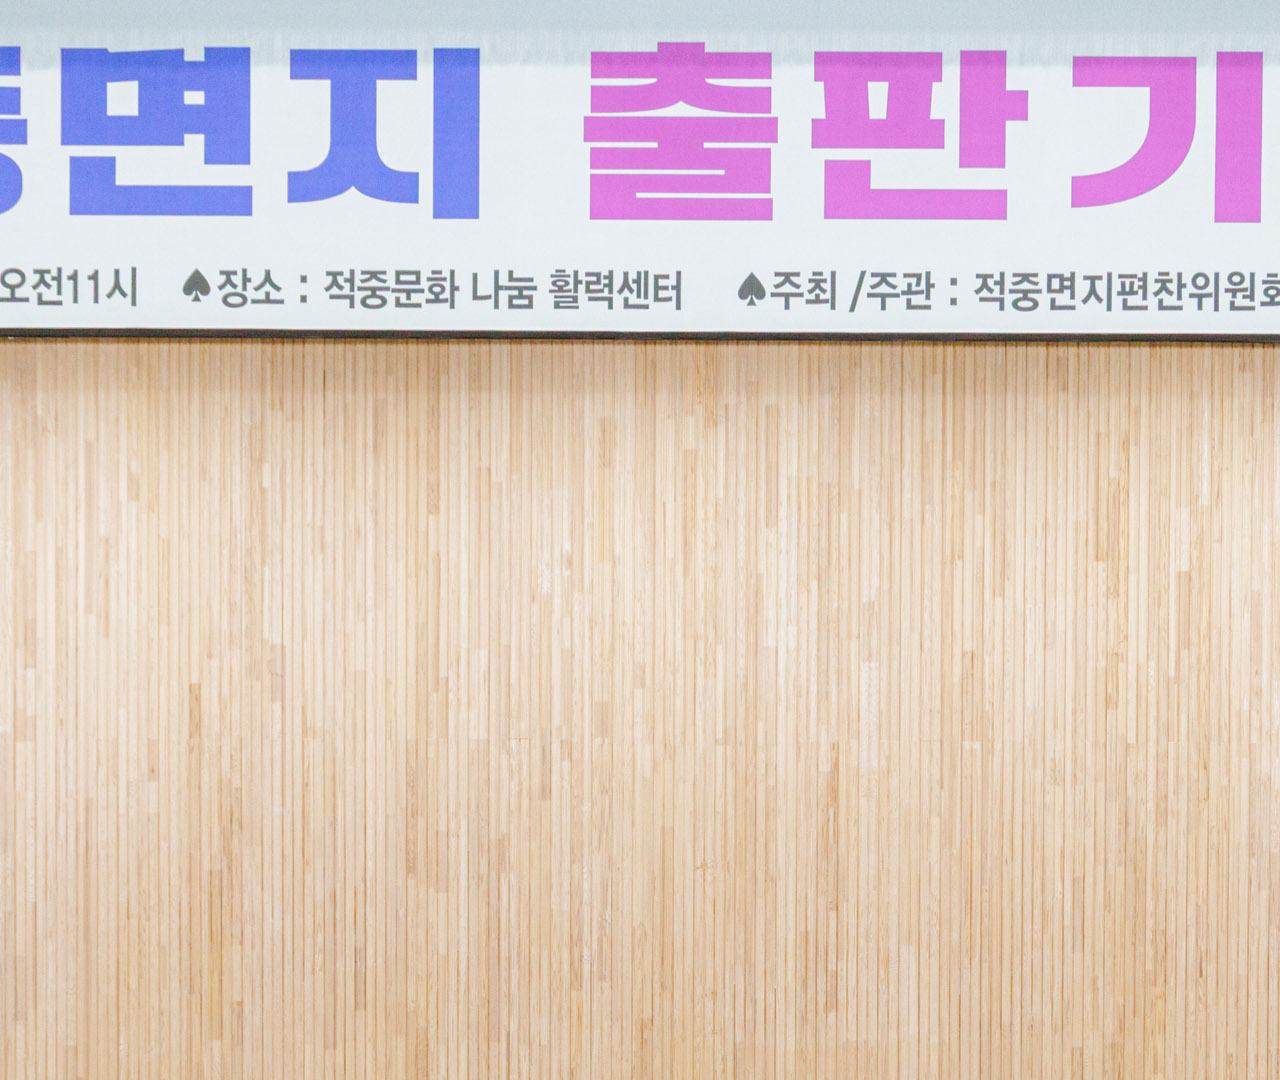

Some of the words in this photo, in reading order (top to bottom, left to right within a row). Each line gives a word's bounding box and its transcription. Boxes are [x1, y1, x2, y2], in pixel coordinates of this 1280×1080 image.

[217, 267, 285, 309] 장소
[323, 268, 460, 310] 적중문화
[471, 269, 538, 310] 나눔
[548, 268, 682, 311] 활력센터
[770, 270, 837, 311] 주최
